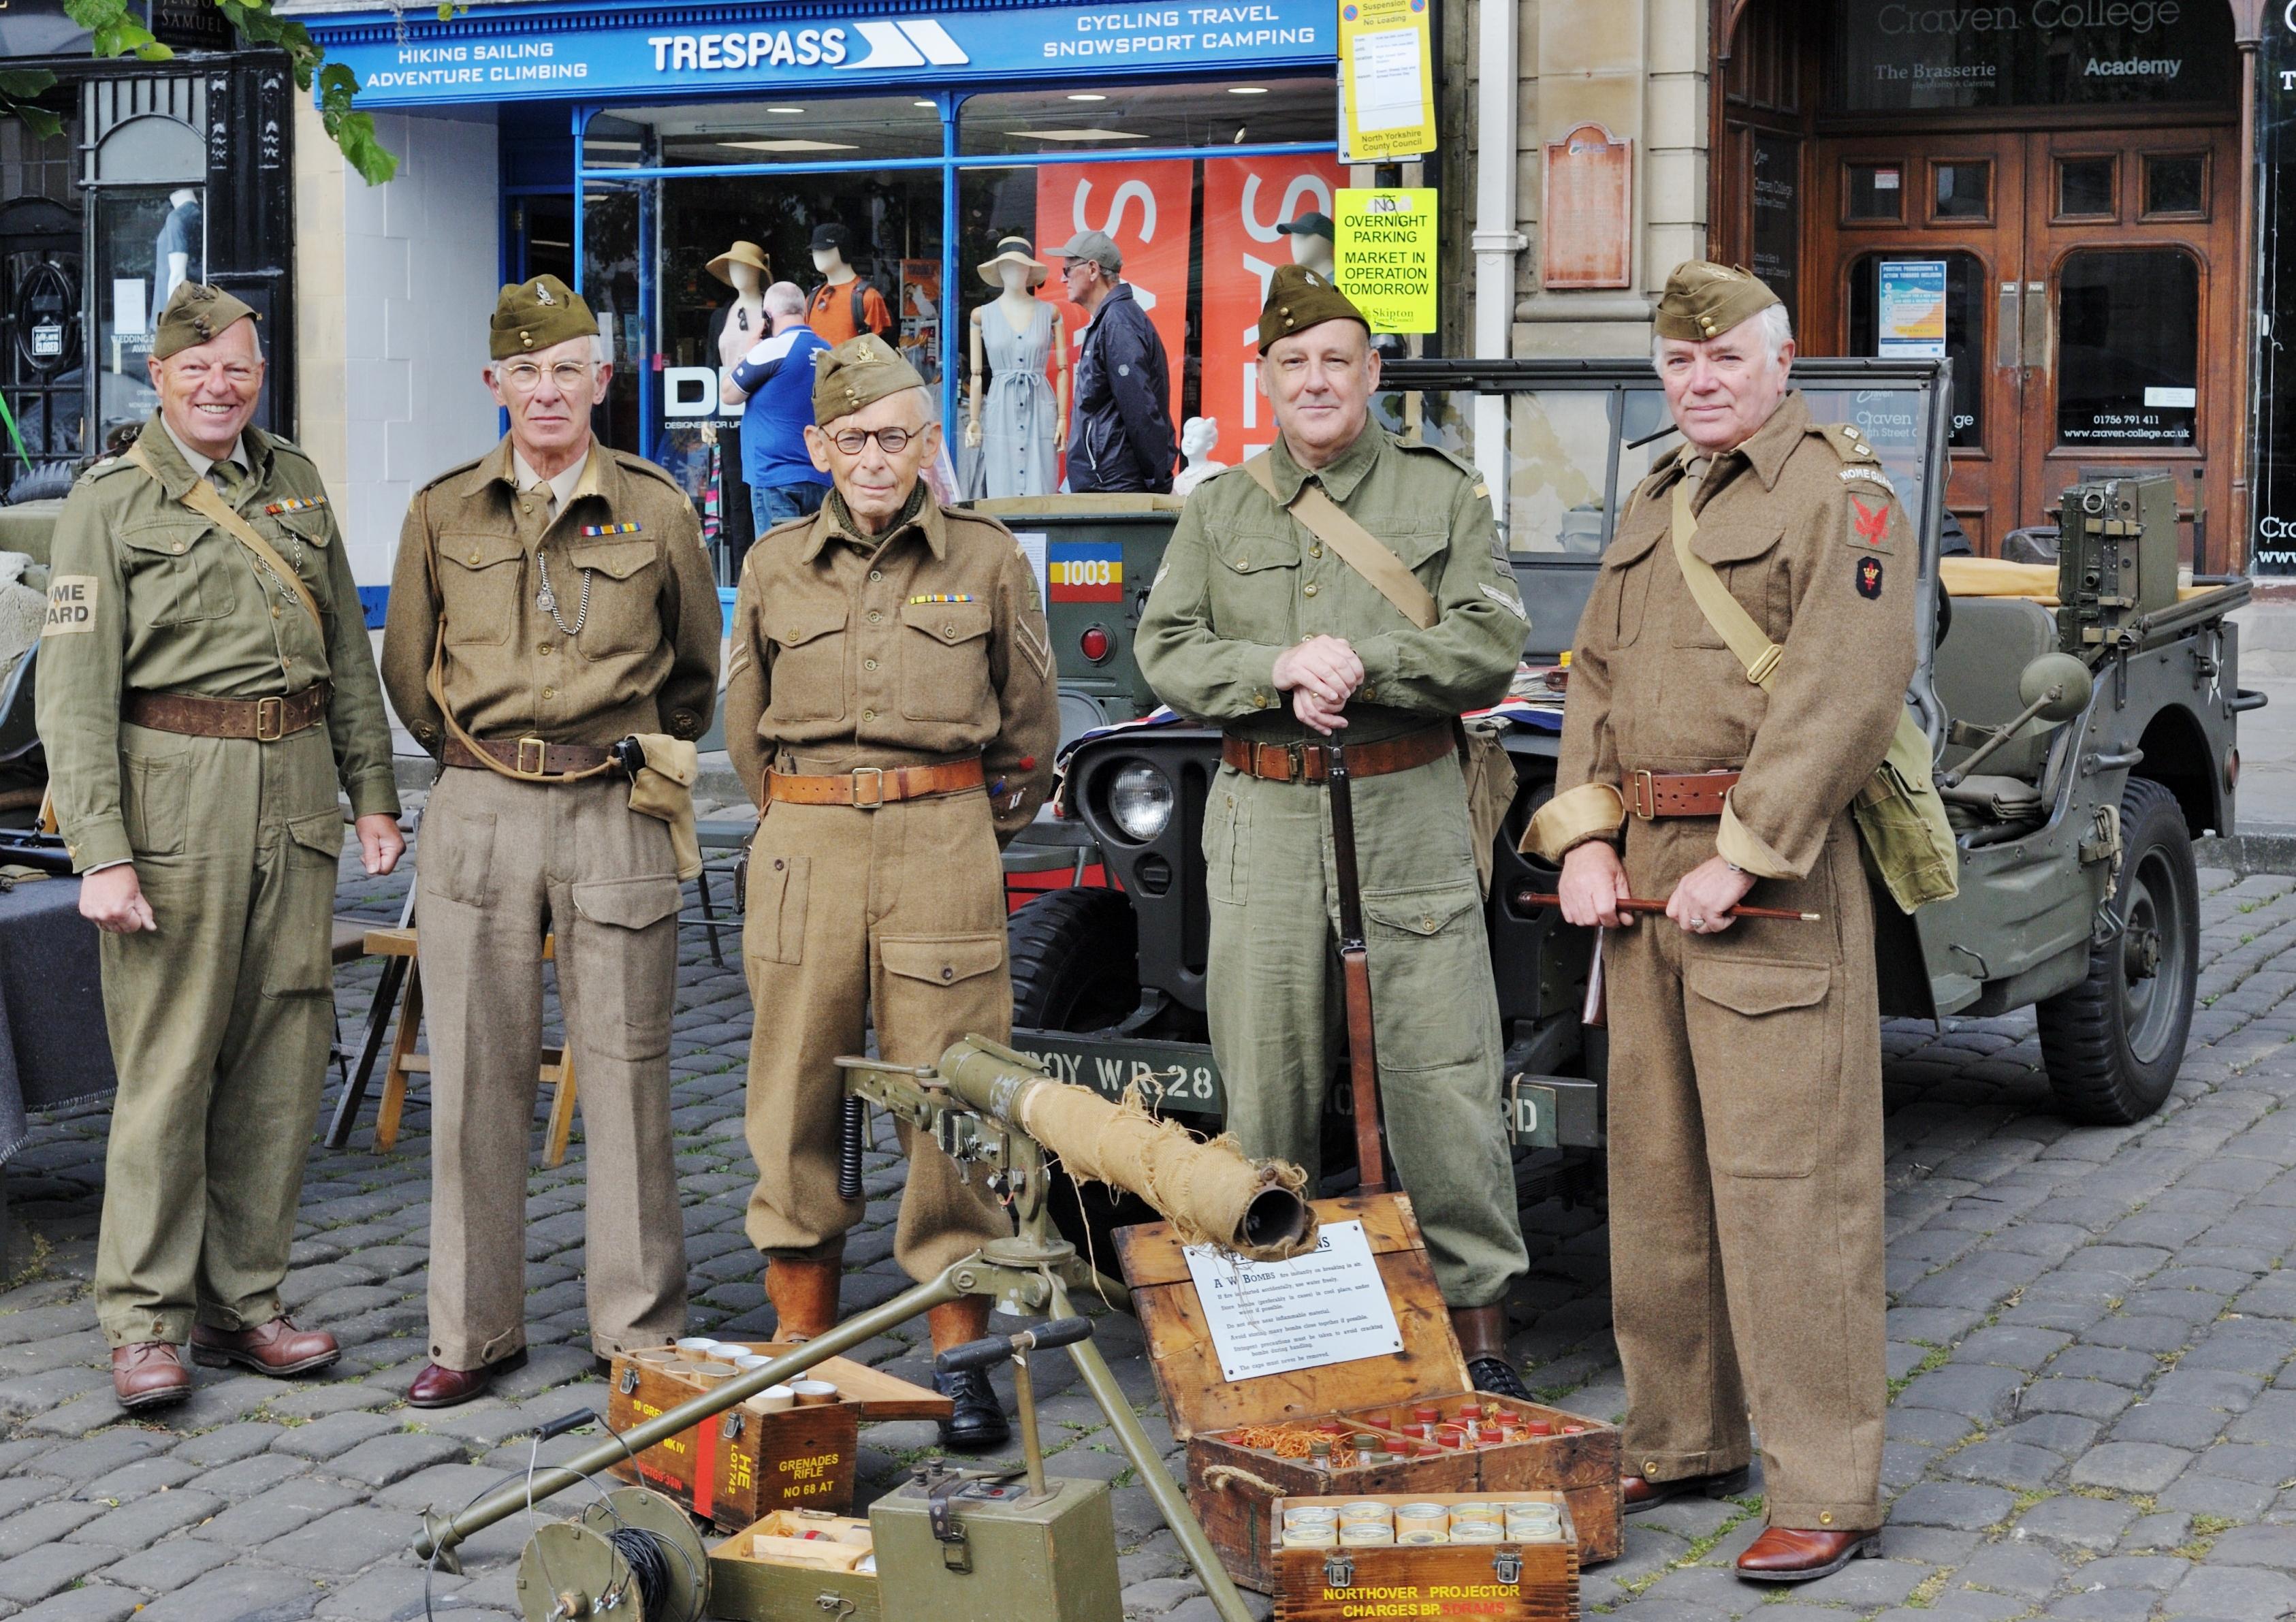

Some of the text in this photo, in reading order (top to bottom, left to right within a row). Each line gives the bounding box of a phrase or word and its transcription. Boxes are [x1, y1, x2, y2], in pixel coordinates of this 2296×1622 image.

[1362, 0, 1406, 11] Suspension
[162, 8, 223, 33] SAMUEL
[1077, 5, 1279, 31] CYCLING TRAVEL
[1363, 15, 1407, 27] No Loading
[1878, 0, 2180, 34] Craven College
[1043, 27, 1316, 57] SNOWSPORT CAMPING
[398, 43, 554, 64] HIKING SAILING
[648, 28, 846, 71] TRESPASS
[1875, 61, 1996, 80] The Brasserie
[2084, 56, 2182, 78] Academy
[366, 63, 588, 87] ADVENTURE CLIMBING
[1963, 78, 1996, 89] Catering
[1361, 129, 1422, 143] North Yorkshire
[1362, 138, 1422, 151] County Council
[1344, 215, 1428, 227] OVERNIGHT
[1354, 231, 1417, 242] PARKING
[1345, 251, 1425, 264] MARKET IN
[1345, 268, 1427, 279] OPERATION
[1342, 283, 1429, 295] TOMORROW
[1372, 308, 1414, 319] Skipton
[110, 334, 150, 343] WEDDING
[132, 345, 154, 353] AVAIL
[1856, 409, 1912, 426] Craven
[2093, 415, 2159, 424] 01756 791 411
[1881, 428, 1909, 438] Street
[2064, 428, 2190, 439] www.craven-college.ac.uk
[1840, 467, 1870, 480] HOME
[1062, 560, 1111, 586] 1003
[50, 584, 84, 601] ME
[47, 605, 89, 624] ARD
[1214, 1278, 1224, 1288] A
[633, 1399, 641, 1411] 10
[728, 1444, 739, 1495] LOT 742
[779, 1453, 840, 1472] GRENADES
[737, 1453, 752, 1490] HE
[793, 1466, 825, 1480] RIFLE
[784, 1480, 834, 1498] NO 68 AT
[1323, 1584, 1520, 1600] NORTHOVER PROJECTOR
[1342, 1603, 1418, 1617] CHARGES
[1450, 1602, 1505, 1615] DRAMS
